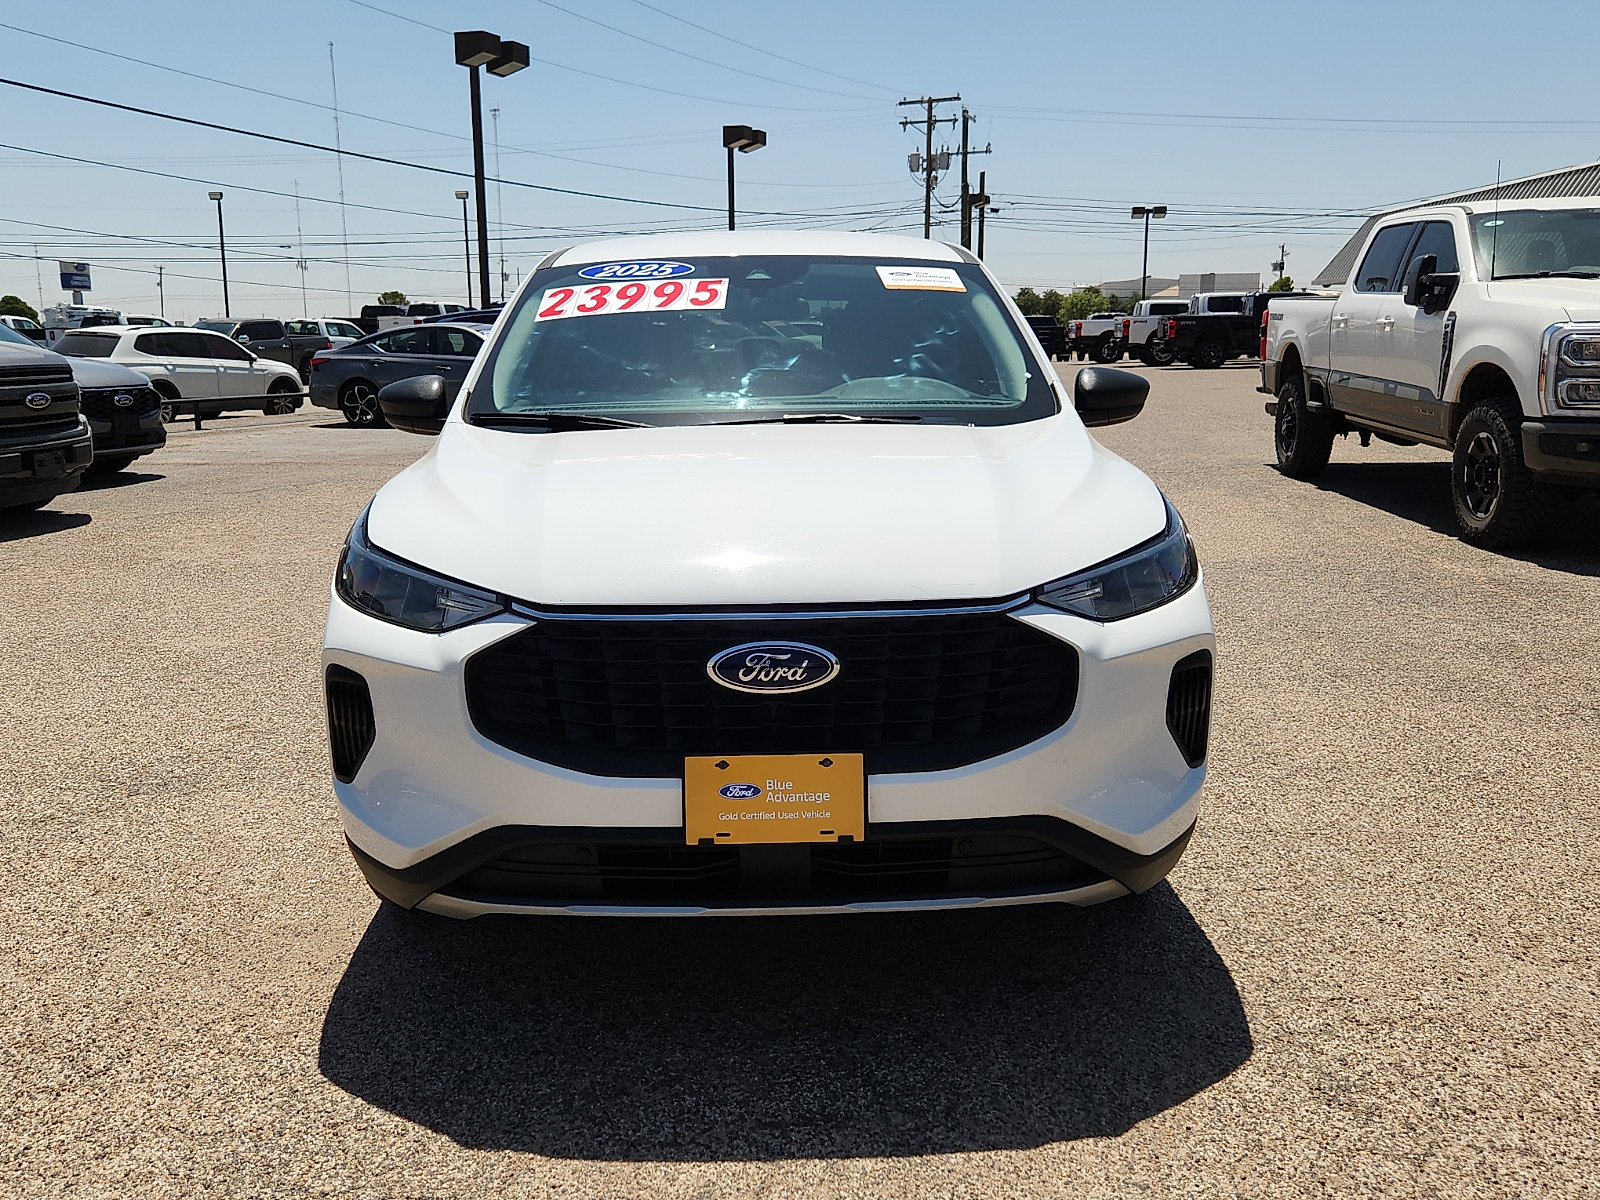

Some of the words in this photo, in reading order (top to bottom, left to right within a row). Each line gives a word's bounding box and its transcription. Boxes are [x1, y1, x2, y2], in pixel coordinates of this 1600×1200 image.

[595, 264, 680, 278] 2025
[539, 280, 725, 318] 23995
[738, 653, 808, 682] Ford
[726, 785, 754, 798] Ford
[766, 779, 793, 791] Blue
[766, 791, 831, 804] Advantage
[718, 812, 738, 821] Gold
[740, 811, 776, 821] Certified
[778, 811, 799, 820] Used
[801, 810, 831, 820] Vehicle
